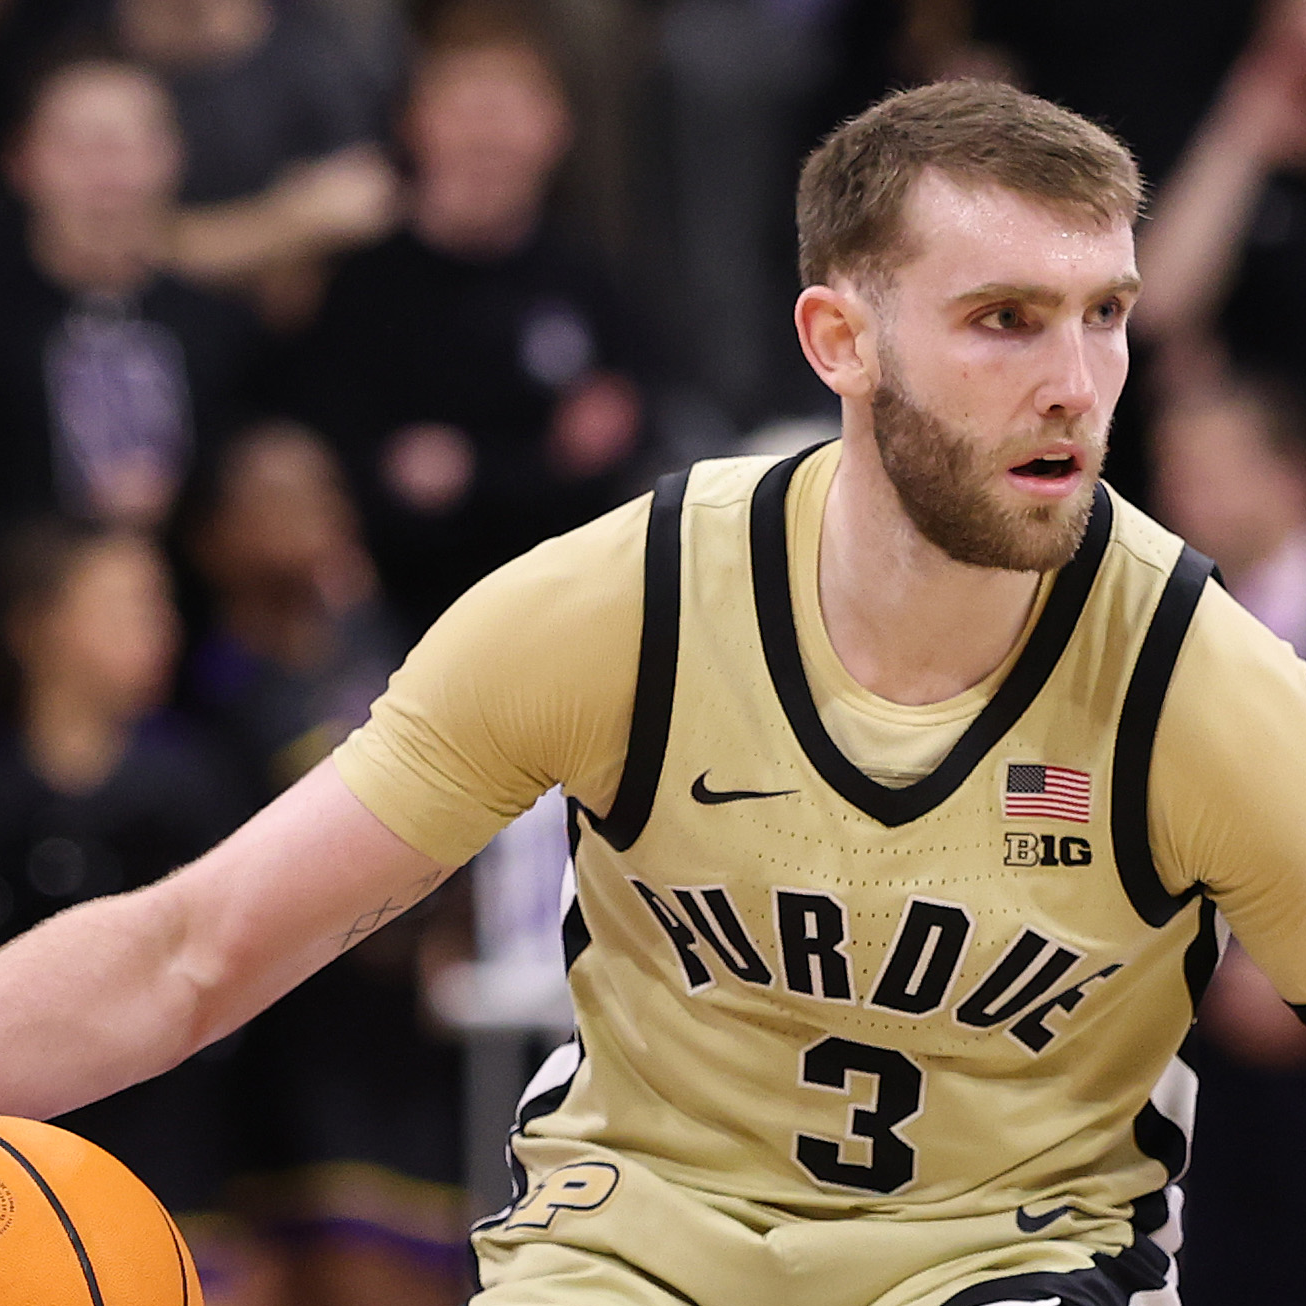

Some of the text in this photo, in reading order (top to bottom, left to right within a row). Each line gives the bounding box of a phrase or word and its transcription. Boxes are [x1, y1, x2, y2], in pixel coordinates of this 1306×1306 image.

[624, 873, 1125, 1059] PURDUE
[791, 1032, 929, 1196] 3
[505, 1160, 623, 1234] P
